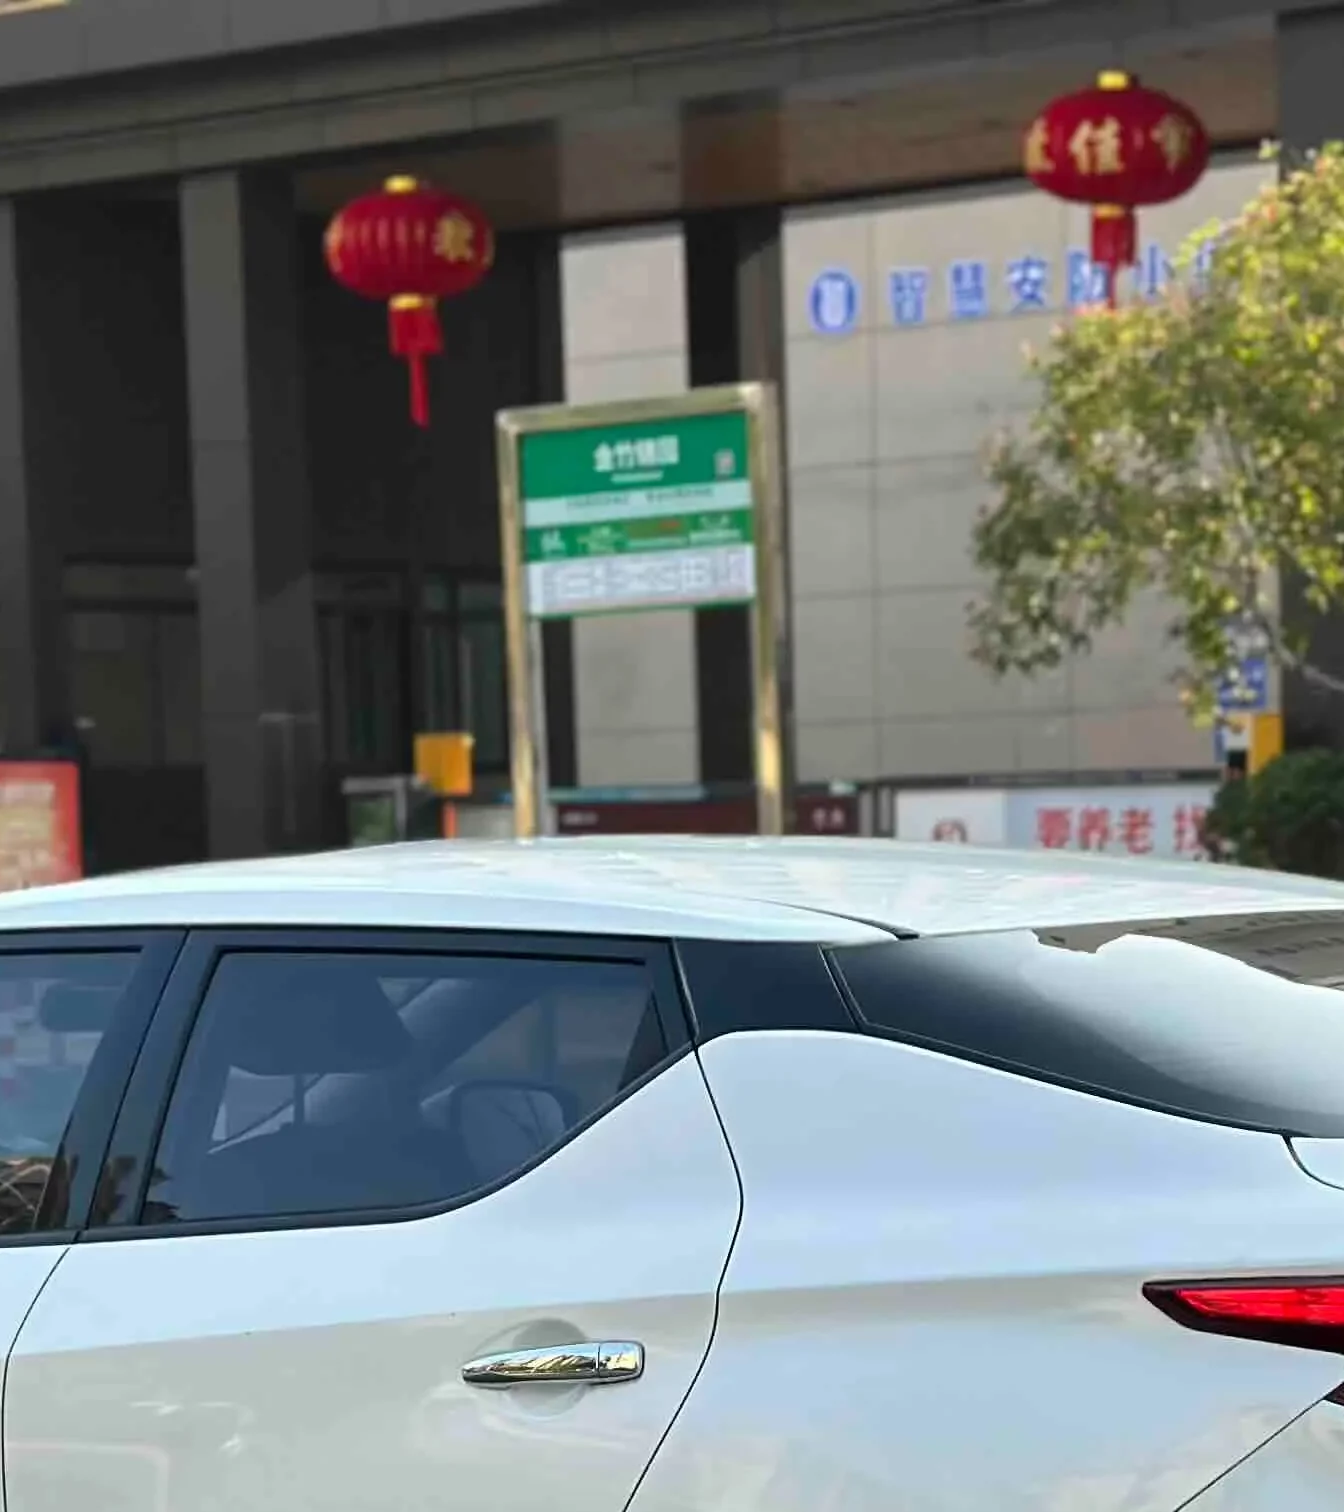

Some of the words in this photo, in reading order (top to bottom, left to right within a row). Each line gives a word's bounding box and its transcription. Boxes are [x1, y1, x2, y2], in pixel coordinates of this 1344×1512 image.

[888, 241, 1216, 327] 智慧安防小
[1036, 805, 1152, 855] 要养老
